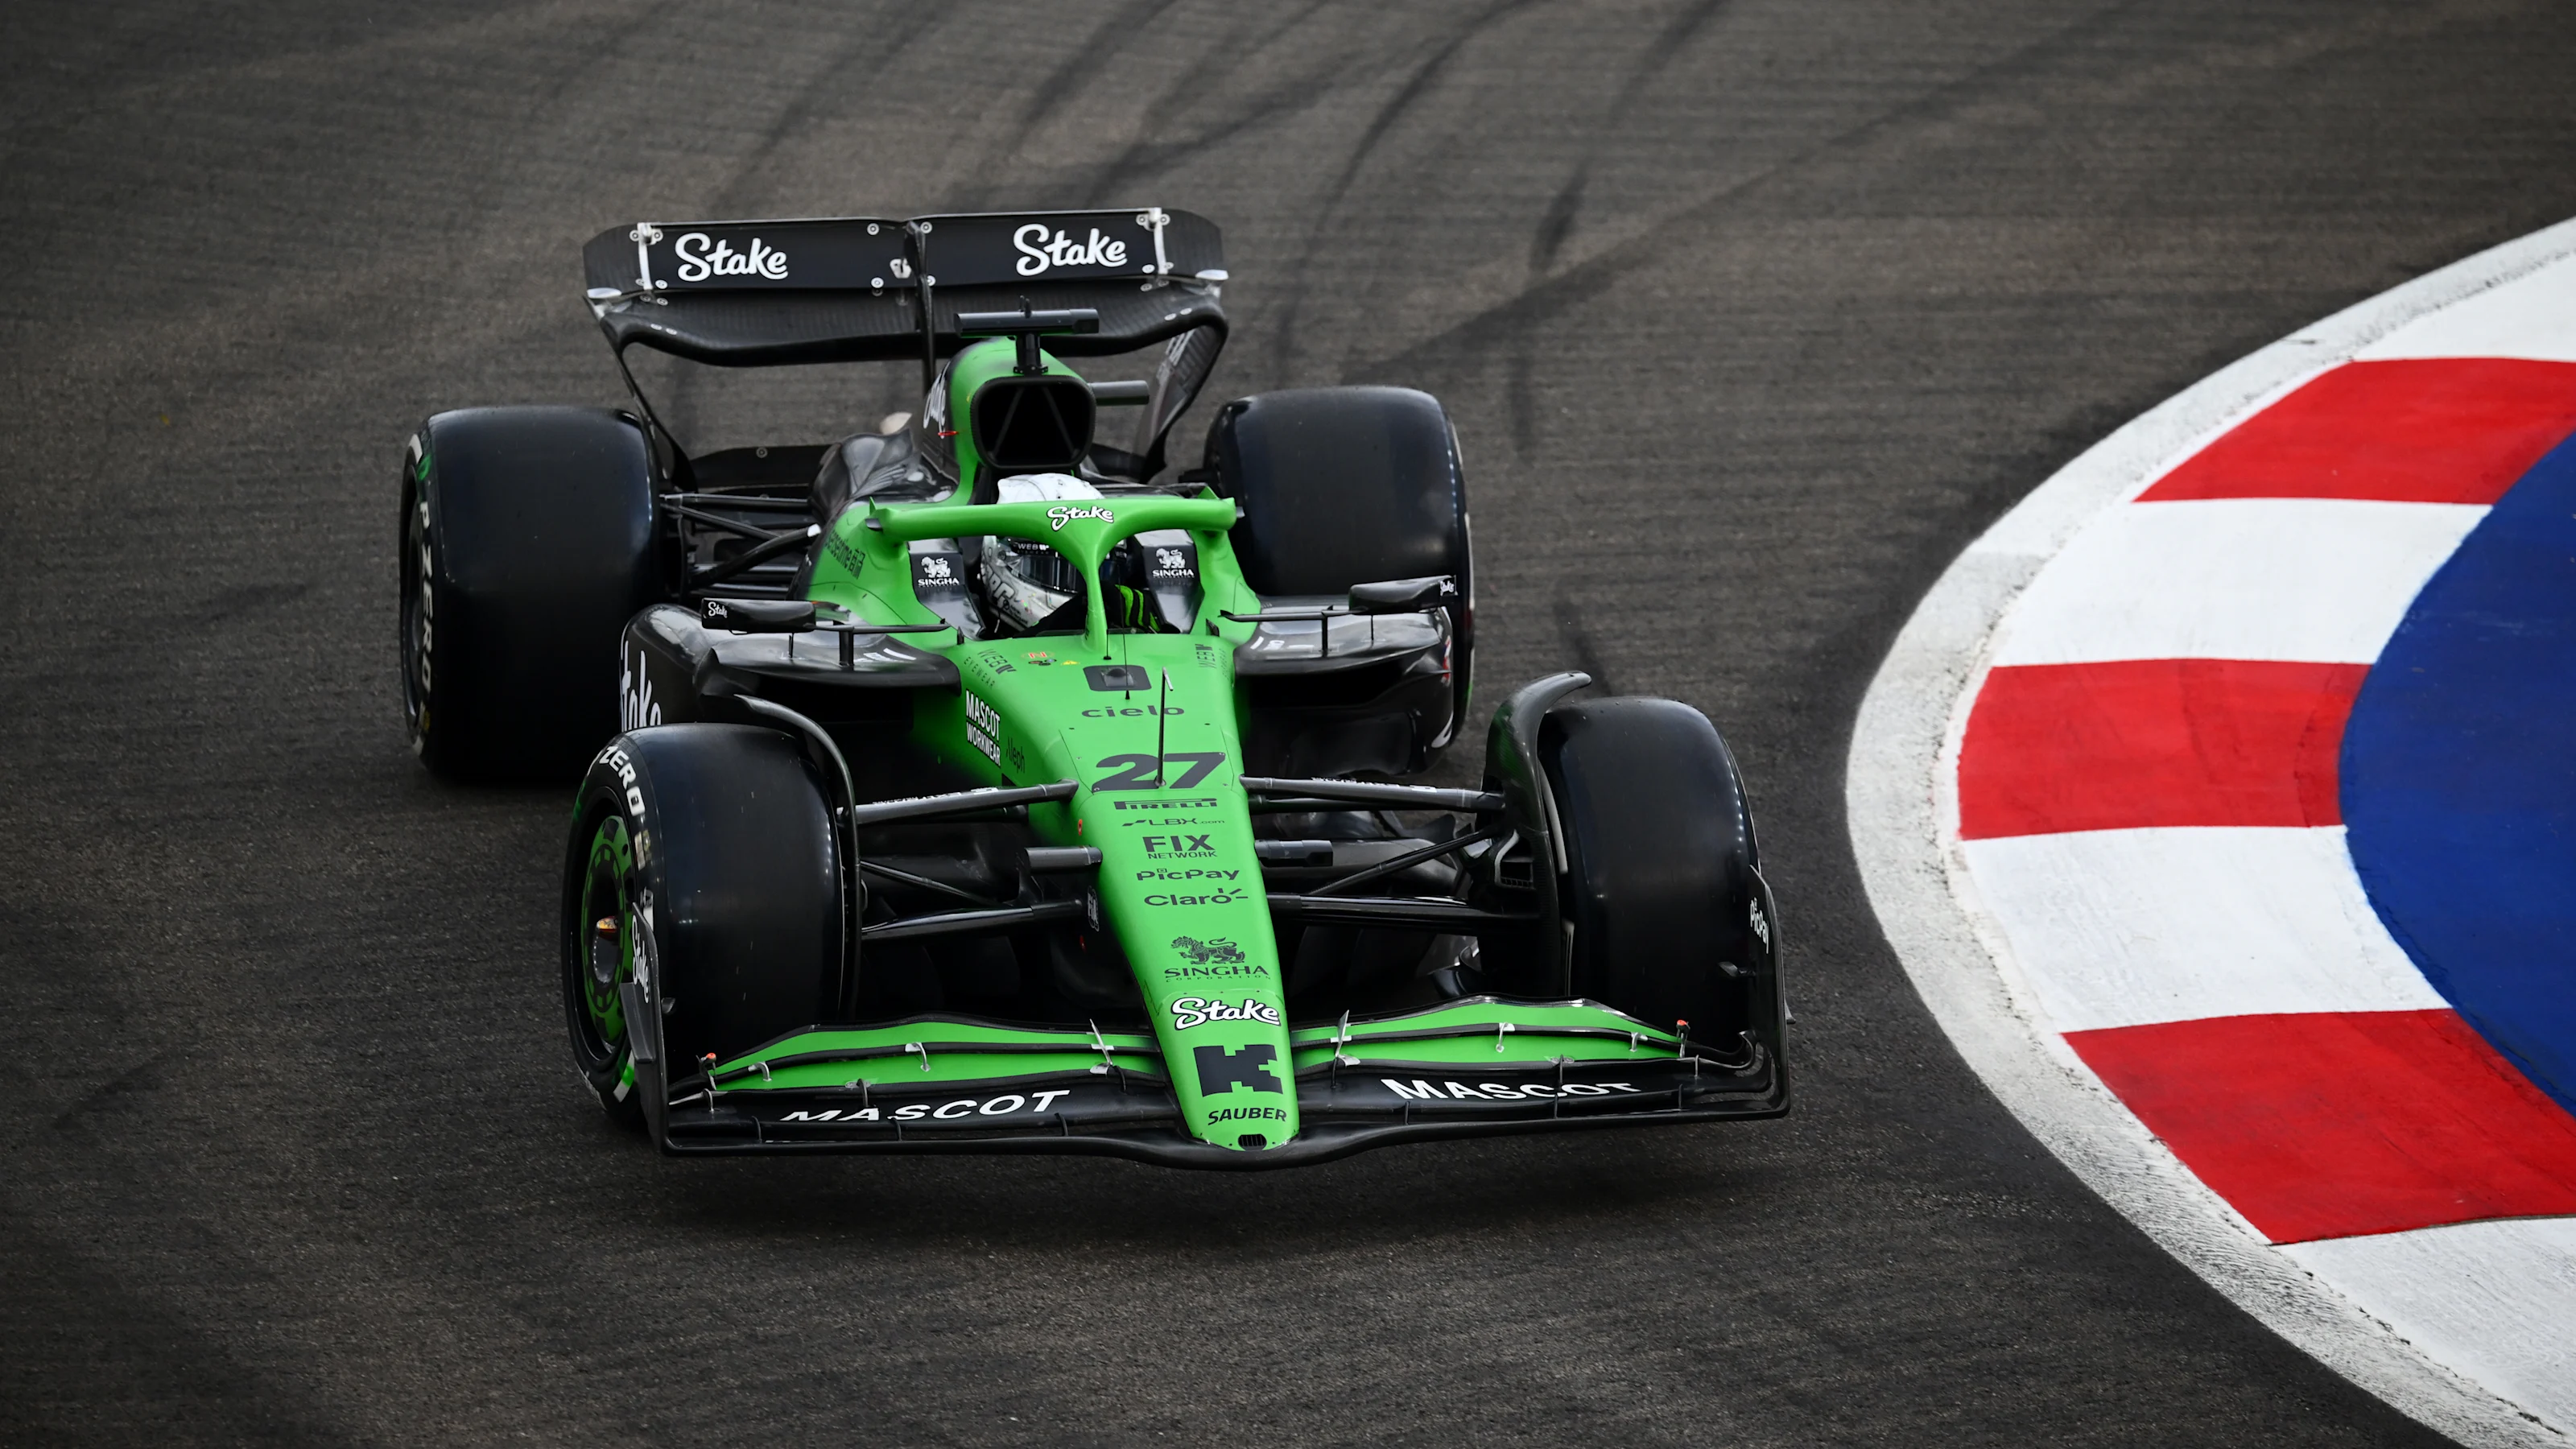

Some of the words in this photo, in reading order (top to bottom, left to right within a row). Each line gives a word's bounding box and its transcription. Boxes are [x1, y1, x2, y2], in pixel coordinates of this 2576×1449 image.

[675, 232, 788, 282] Stake
[1013, 224, 1127, 276] Stake
[419, 502, 430, 530] P
[1046, 506, 1114, 532] Stake
[918, 578, 960, 587] SINGHA
[421, 545, 434, 694] ZERO
[964, 656, 996, 689] EYEWEAR
[966, 690, 1000, 741] MASCOT
[1082, 705, 1184, 718] cielo
[966, 721, 1001, 766] WORKWEAR
[599, 745, 646, 816] ZERO
[1092, 752, 1226, 794] 27
[1113, 798, 1218, 810] PIRELLI
[1142, 834, 1216, 852] FIX
[1148, 850, 1218, 860] NETWORK
[1136, 869, 1240, 881] PicPay
[1144, 888, 1235, 906] Claro
[1164, 965, 1269, 979] SINGHA
[1166, 975, 1271, 984] CORPORATION
[1171, 997, 1282, 1030] Stake
[1381, 1079, 1642, 1100] MASCOT
[779, 1089, 1071, 1122] MASCOT
[1208, 1107, 1288, 1126] SAUBER
